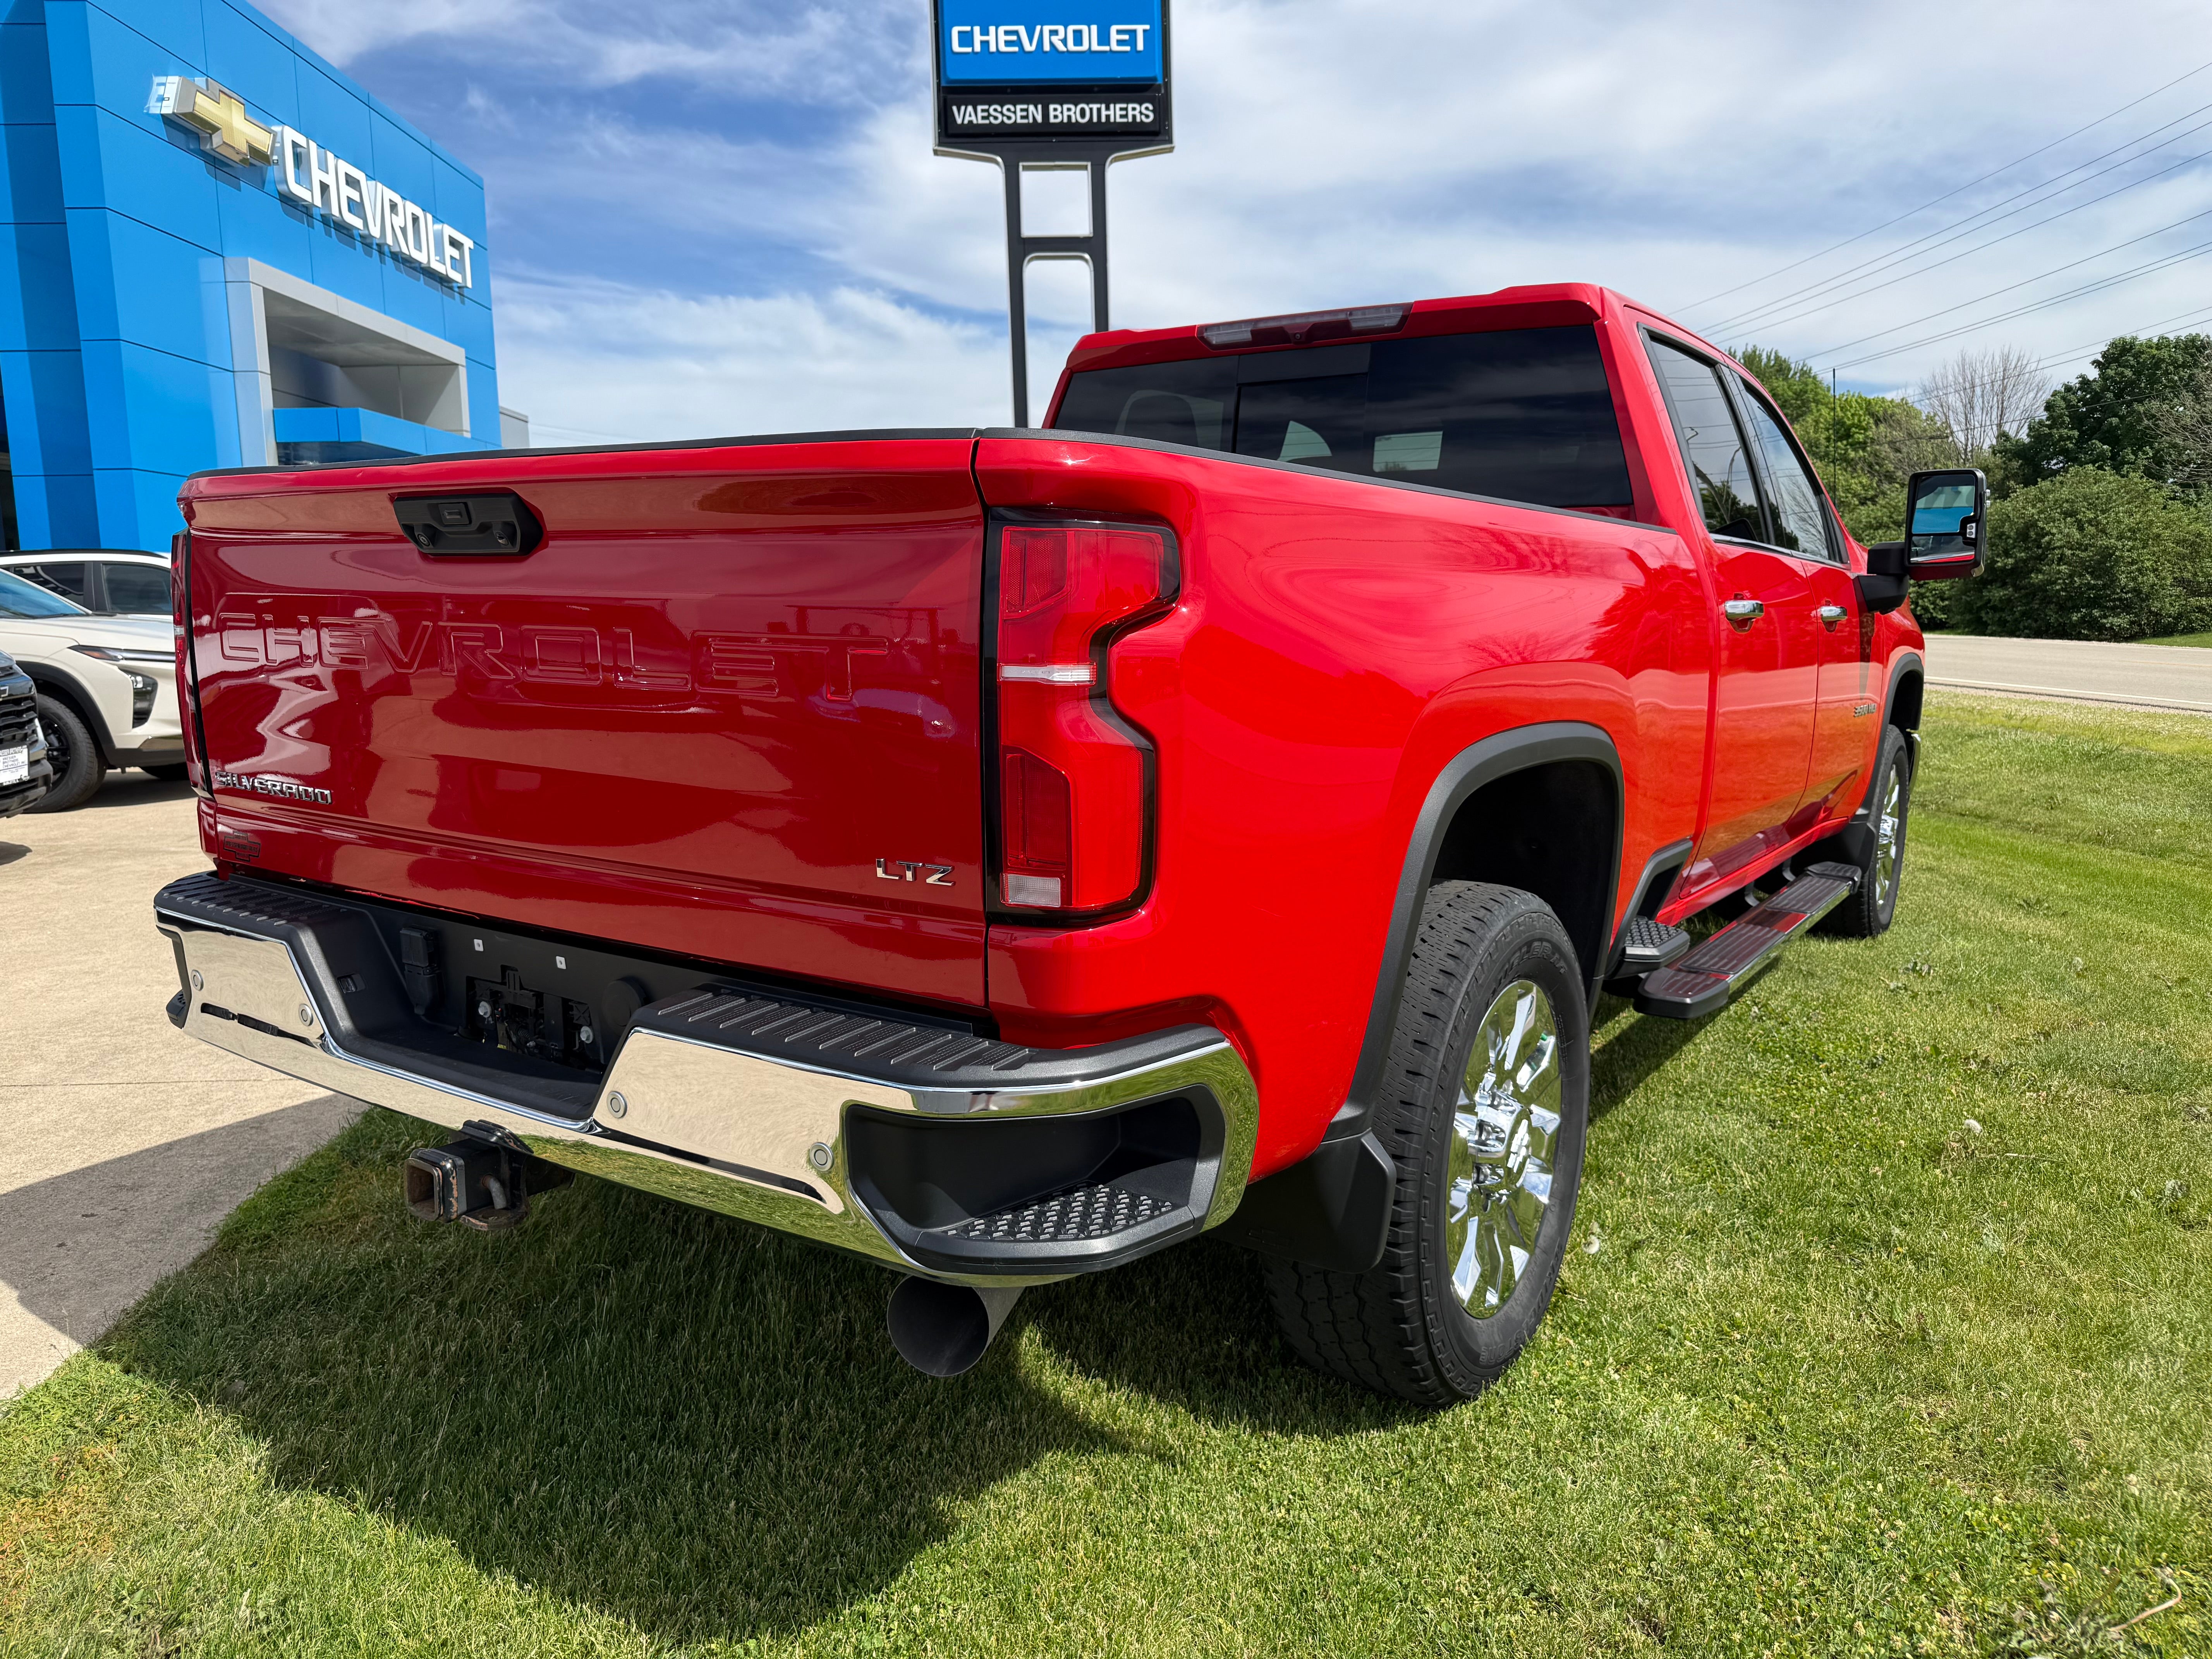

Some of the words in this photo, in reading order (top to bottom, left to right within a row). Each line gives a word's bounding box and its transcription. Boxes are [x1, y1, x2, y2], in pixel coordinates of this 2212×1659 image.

[951, 25, 1150, 53] CHEVROLET
[952, 105, 1042, 125] VAESSEN
[1049, 103, 1154, 123] BROTHERS
[272, 125, 473, 289] CHEVROLET
[218, 613, 888, 701] CHEVROLET
[215, 770, 332, 804] SILVERADO
[876, 858, 955, 886] LTZ
